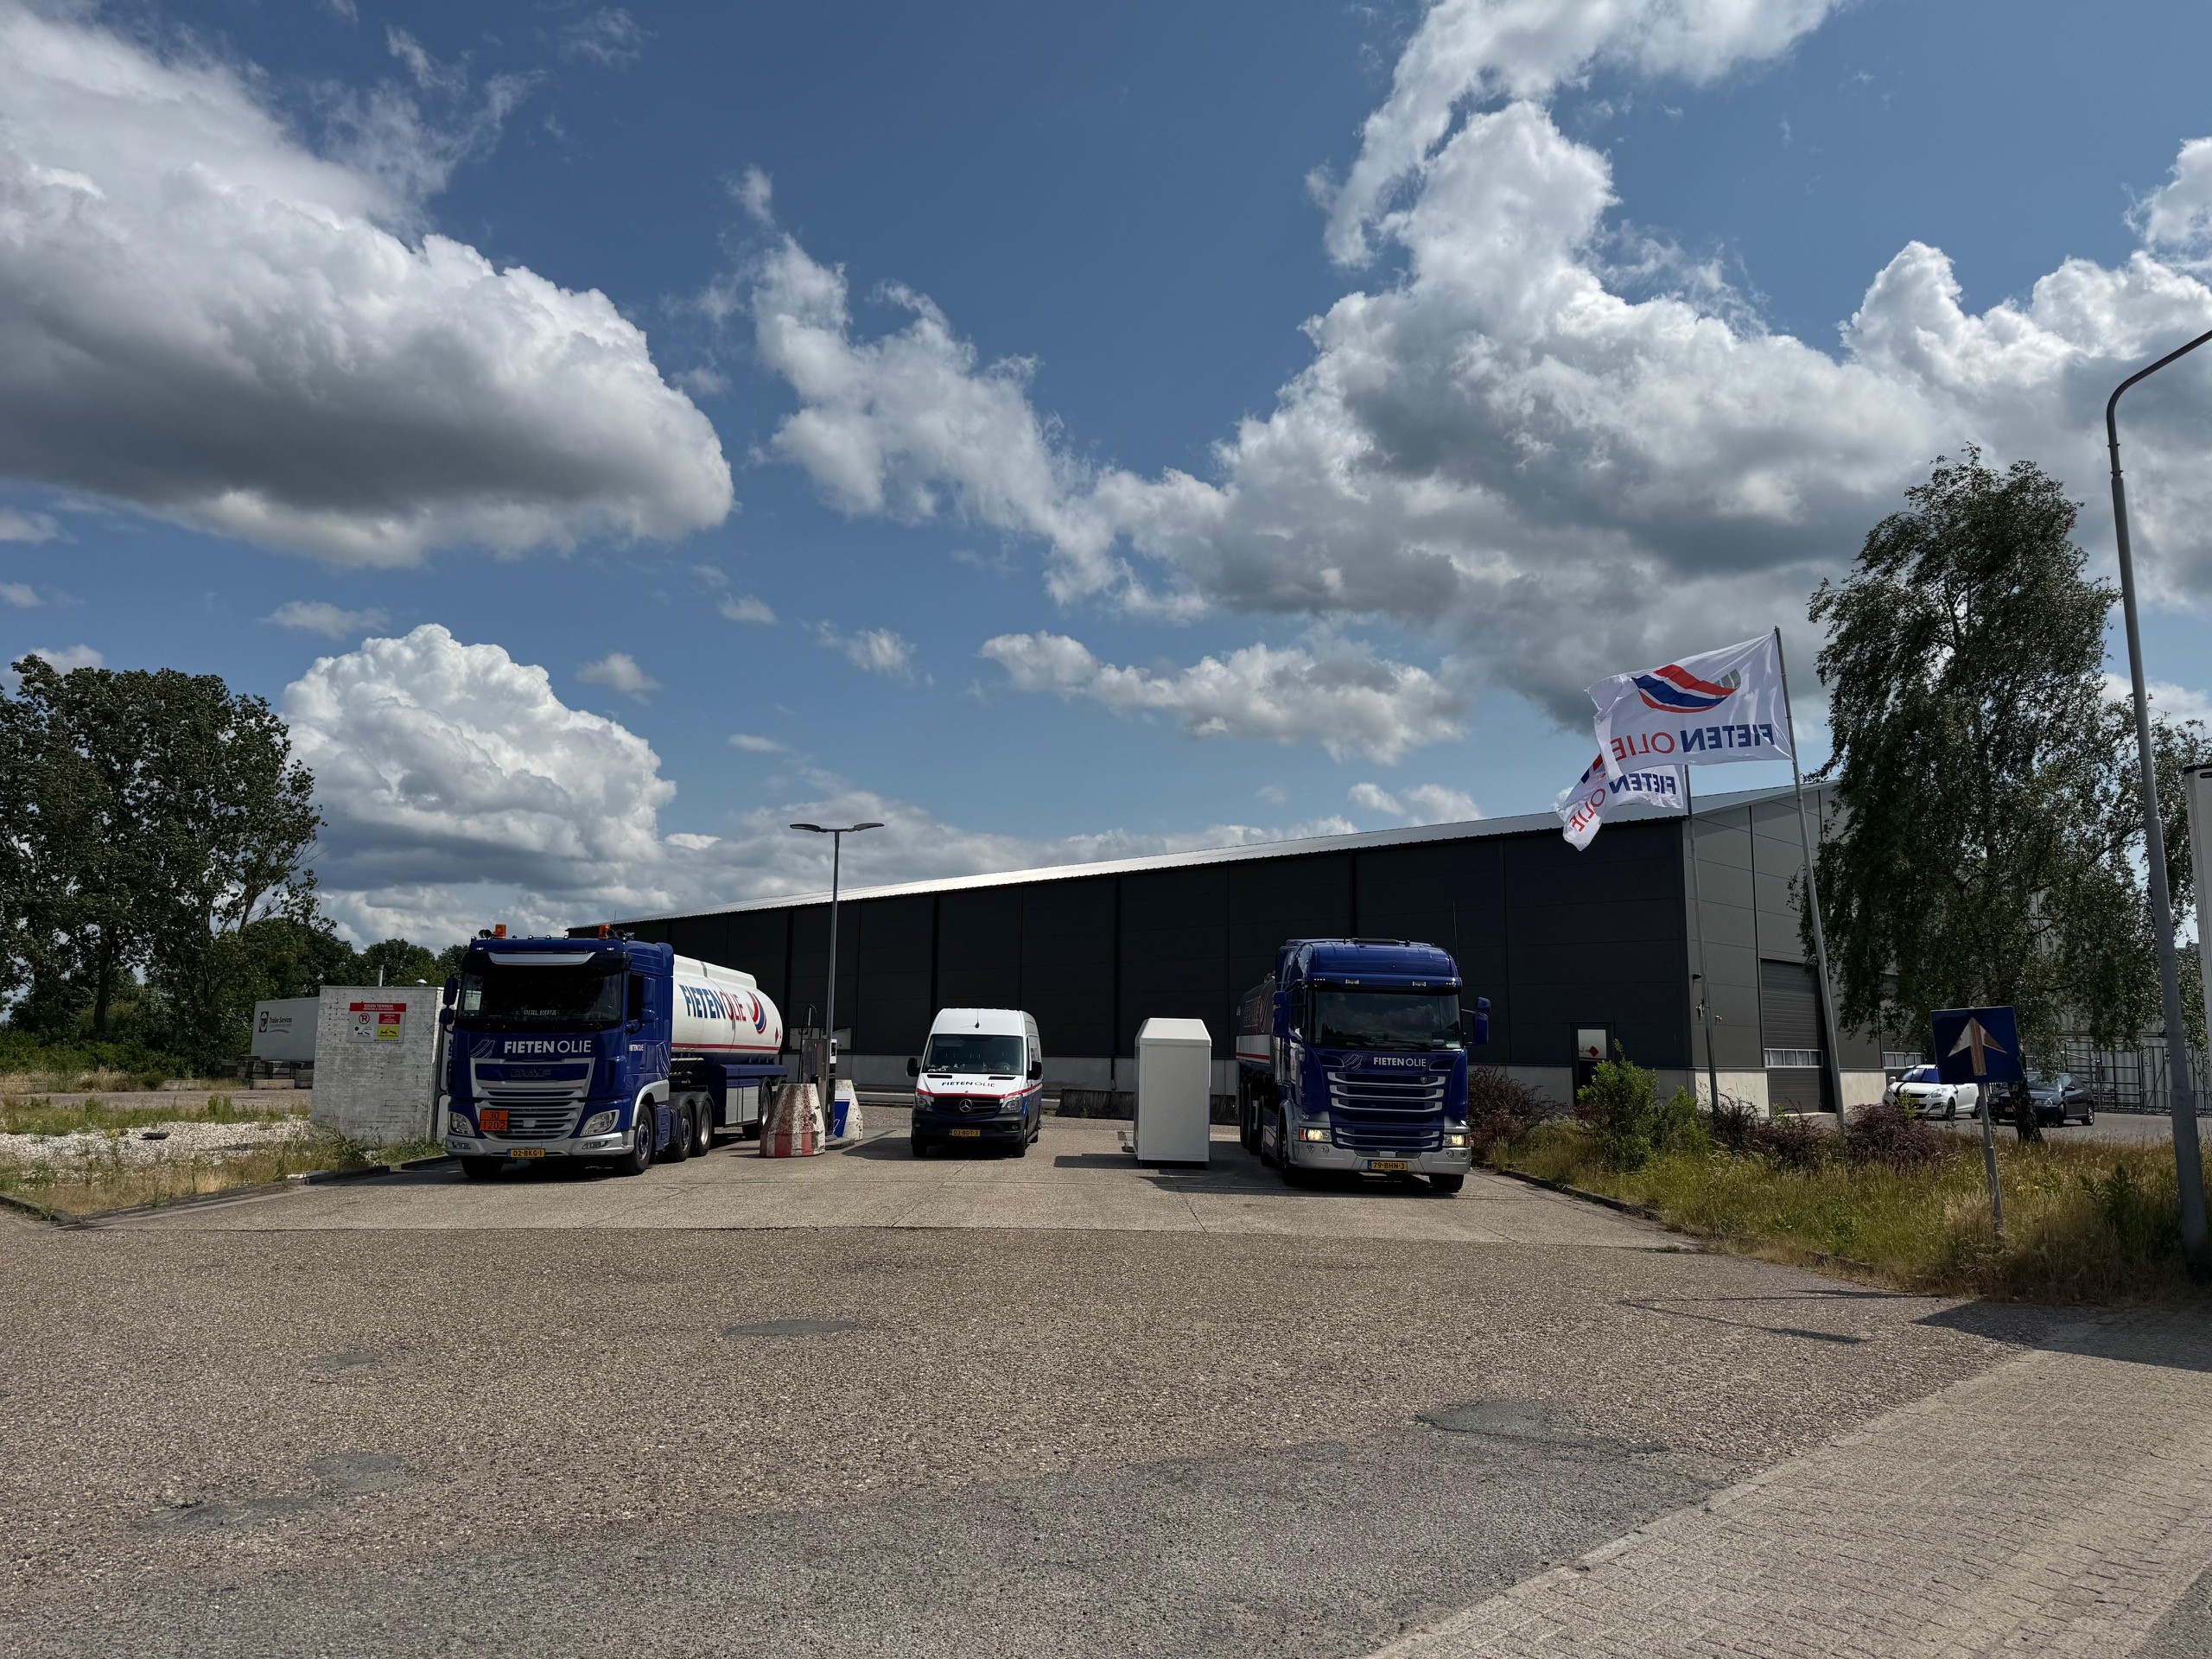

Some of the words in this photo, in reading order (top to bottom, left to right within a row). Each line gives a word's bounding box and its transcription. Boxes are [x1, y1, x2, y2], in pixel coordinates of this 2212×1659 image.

[678, 984, 726, 1019] FIETEN
[719, 990, 747, 1021] OLIE
[504, 1040, 556, 1054] FIETEN
[556, 1039, 592, 1053] OLIE
[1373, 1057, 1405, 1066] FIETEN
[1405, 1058, 1427, 1067] OLIE
[511, 1069, 552, 1077] DAF
[484, 1121, 505, 1129] 1202
